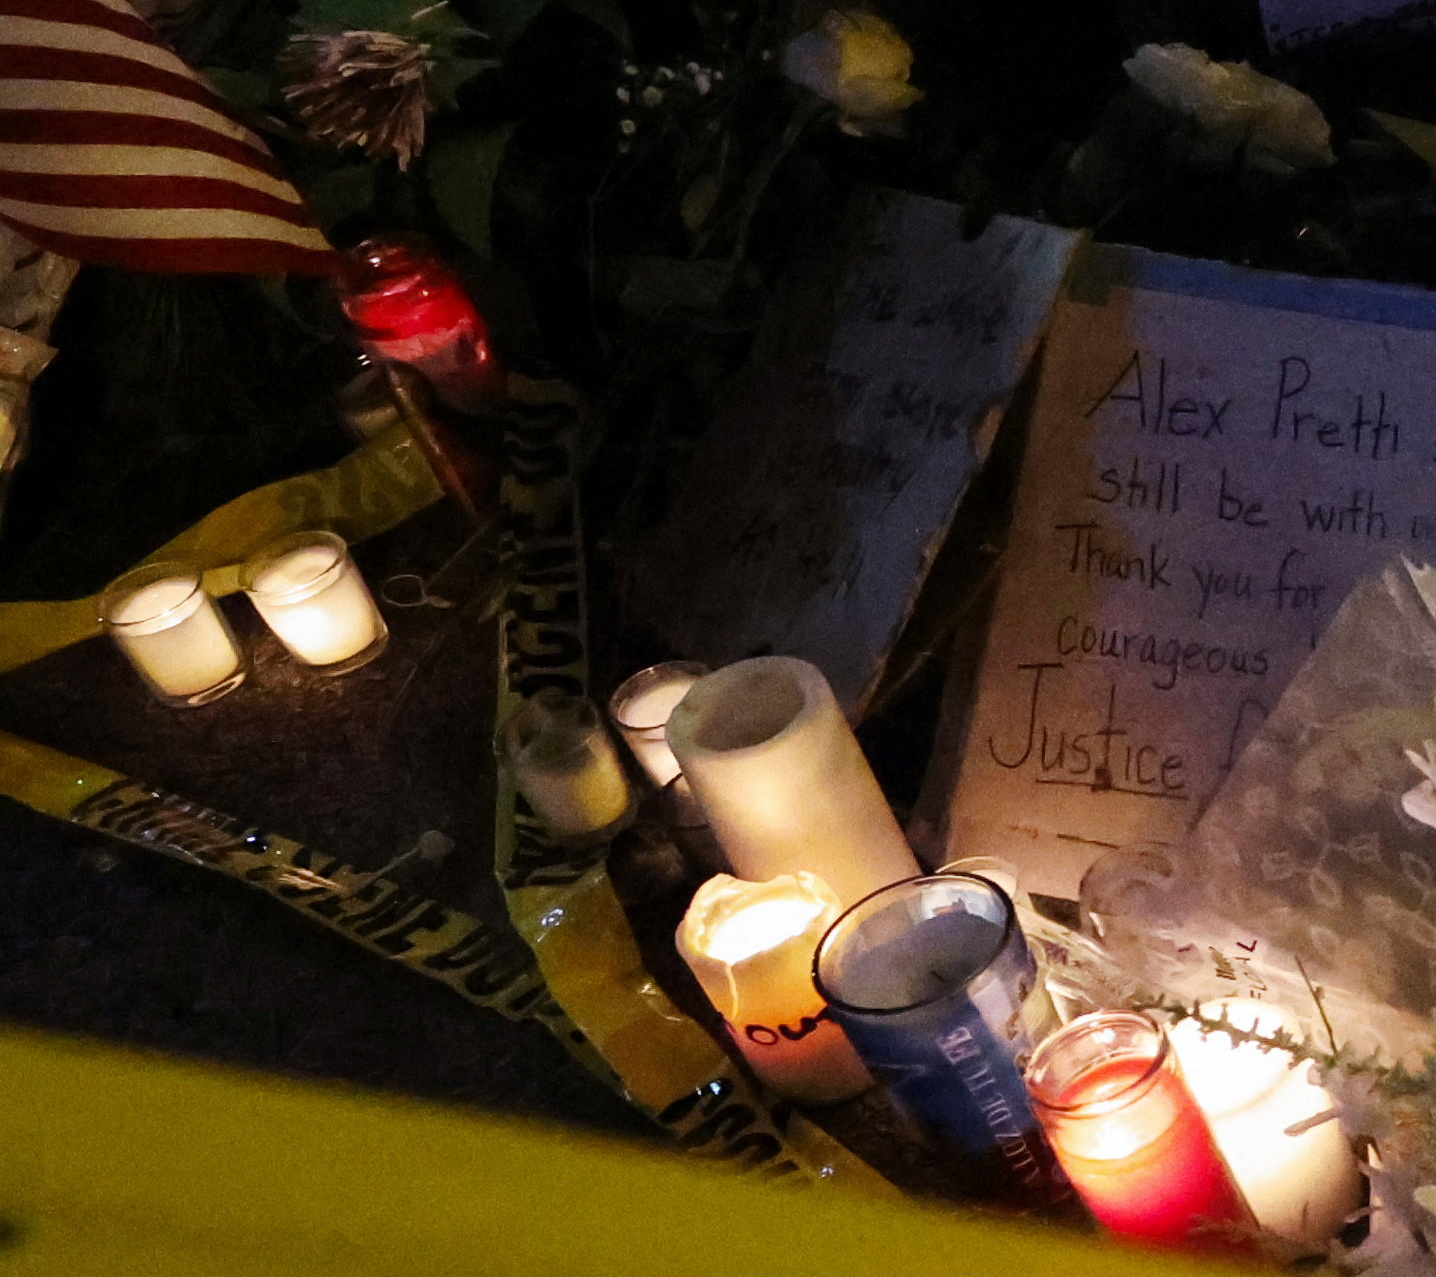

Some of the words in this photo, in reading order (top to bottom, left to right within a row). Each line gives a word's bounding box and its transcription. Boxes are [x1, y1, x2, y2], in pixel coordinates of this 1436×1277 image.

[1085, 350, 1234, 439] Alex
[1269, 356, 1403, 463] Pretti
[1085, 465, 1182, 513] still
[1218, 469, 1270, 528] be
[1302, 490, 1390, 541] with
[1055, 524, 1170, 593] Thank
[1194, 567, 1253, 611] you
[1269, 550, 1326, 611] for
[1056, 615, 1270, 691] courageous
[987, 663, 1189, 791] Justice
[934, 1025, 981, 1066] FE
[963, 1062, 996, 1095] TU
[980, 1092, 1013, 1126] DE
